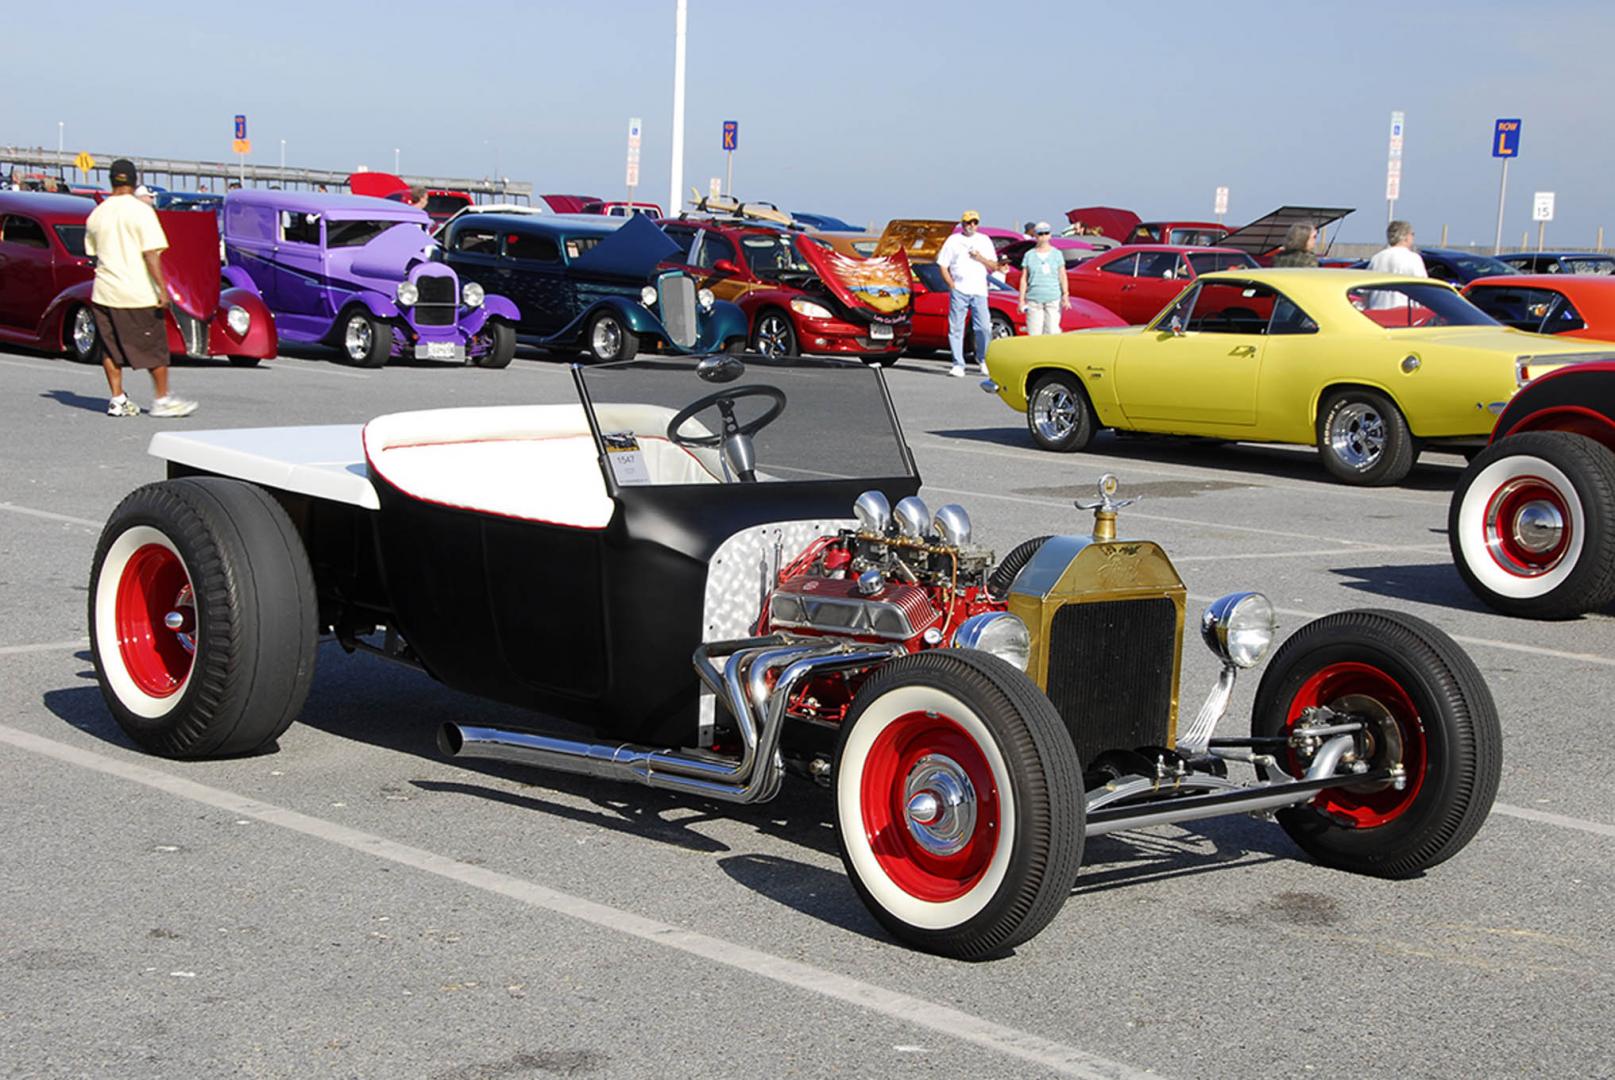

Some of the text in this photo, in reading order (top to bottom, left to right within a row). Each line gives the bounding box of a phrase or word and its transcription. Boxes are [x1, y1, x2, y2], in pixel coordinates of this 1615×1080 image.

[236, 123, 244, 138] J
[1499, 122, 1518, 131] ROW
[725, 131, 735, 147] K
[1499, 133, 1512, 154] L
[1537, 206, 1550, 217] 15
[617, 454, 635, 464] 1547
